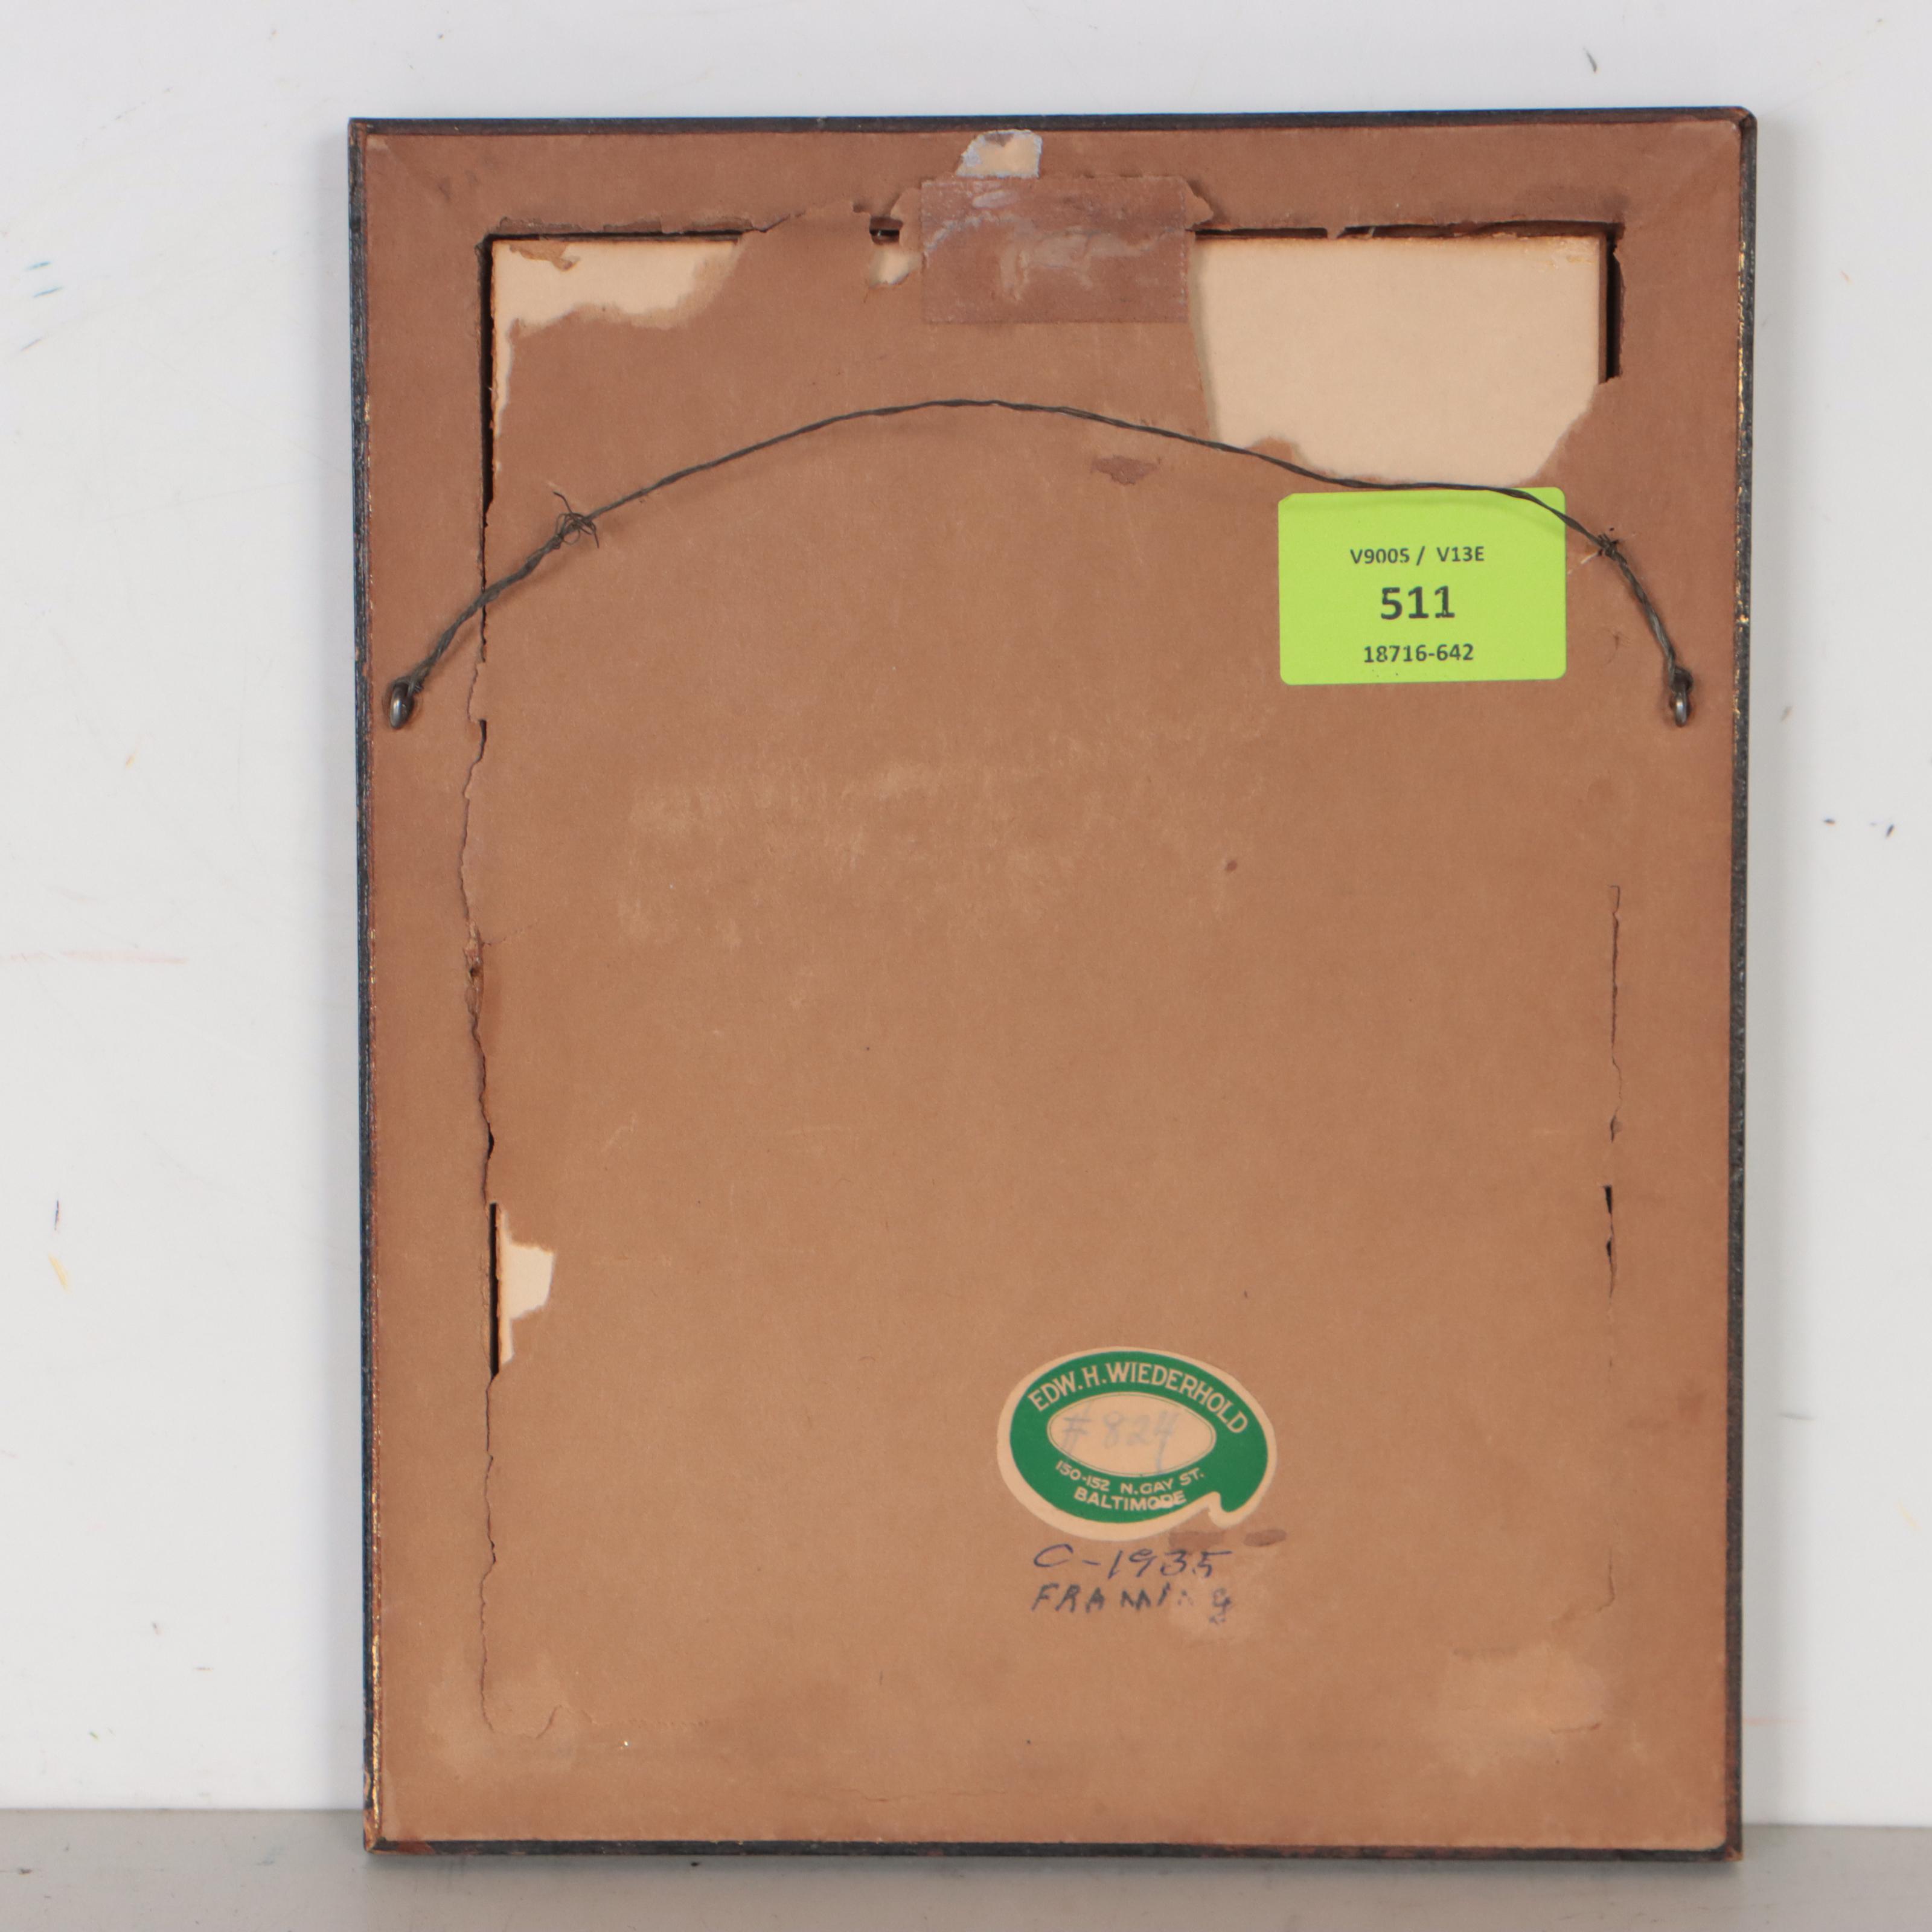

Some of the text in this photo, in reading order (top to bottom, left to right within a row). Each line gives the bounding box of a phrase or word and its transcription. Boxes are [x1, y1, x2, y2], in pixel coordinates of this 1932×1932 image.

[1350, 545, 1485, 566] V9005 / V13E
[1380, 585, 1456, 620] 511
[1364, 644, 1474, 663] 18716-642
[1106, 1361, 1249, 1434] WIEDERHOLD
[1056, 1460, 1111, 1492] 150-152
[1179, 1467, 1204, 1486] ST.
